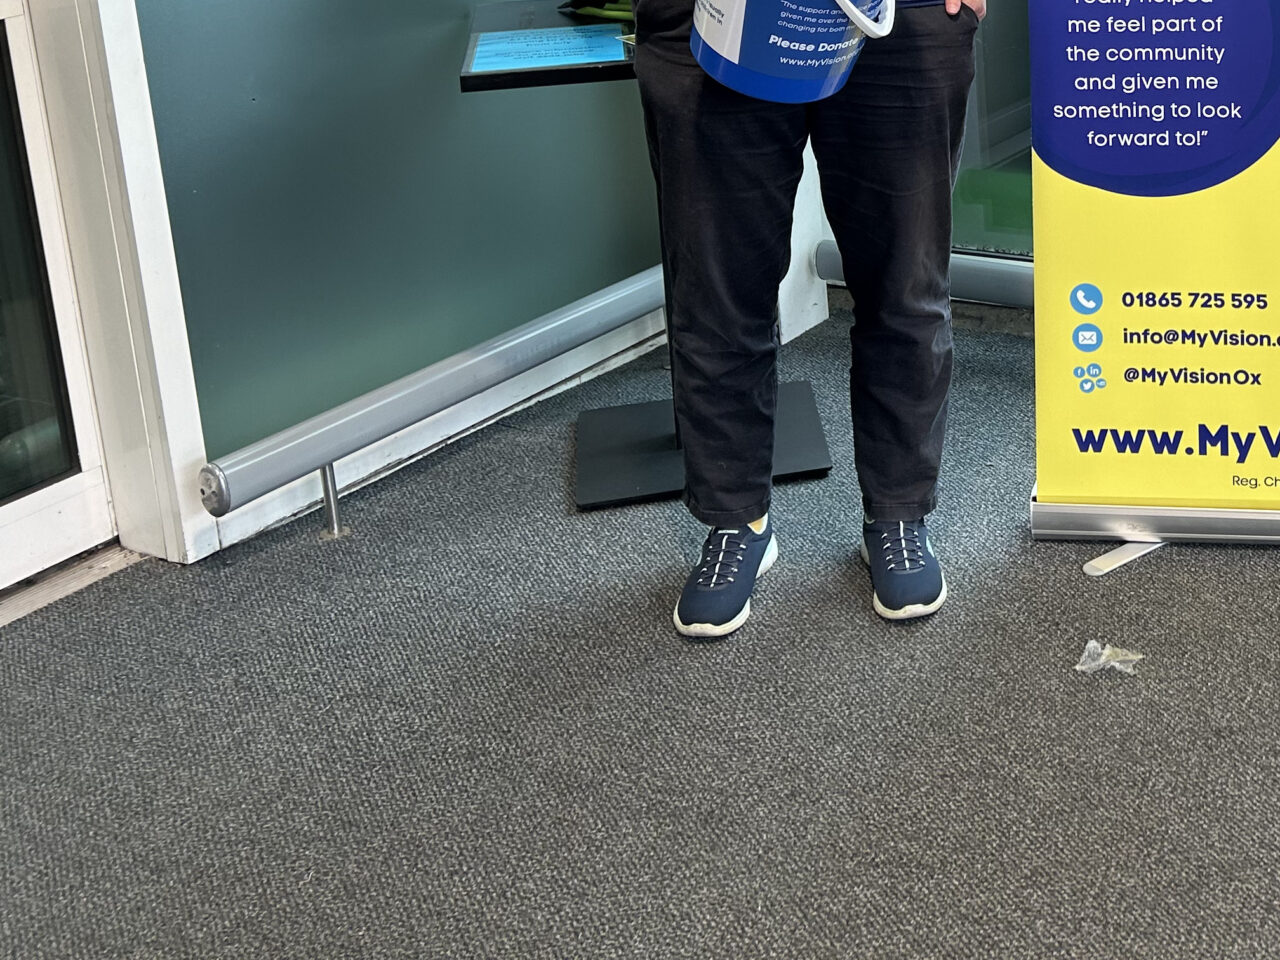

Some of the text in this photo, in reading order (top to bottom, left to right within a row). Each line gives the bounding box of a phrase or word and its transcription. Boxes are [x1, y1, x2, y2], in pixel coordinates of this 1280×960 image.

[780, 11, 803, 21] given
[803, 15, 818, 23] me
[798, 3, 830, 15] support
[777, 20, 816, 34] changing
[817, 24, 829, 33] for
[1067, 14, 1223, 36] me feel part of
[768, 34, 860, 53] Please Donate
[1066, 44, 1225, 66] the community
[1074, 73, 1219, 96] and given me
[1053, 101, 1242, 125] something to look
[1086, 129, 1170, 147] forward
[1121, 292, 1268, 310] 01865 725 595
[1123, 367, 1262, 388] @MyVisionOx
[1232, 475, 1261, 491] Reg.
